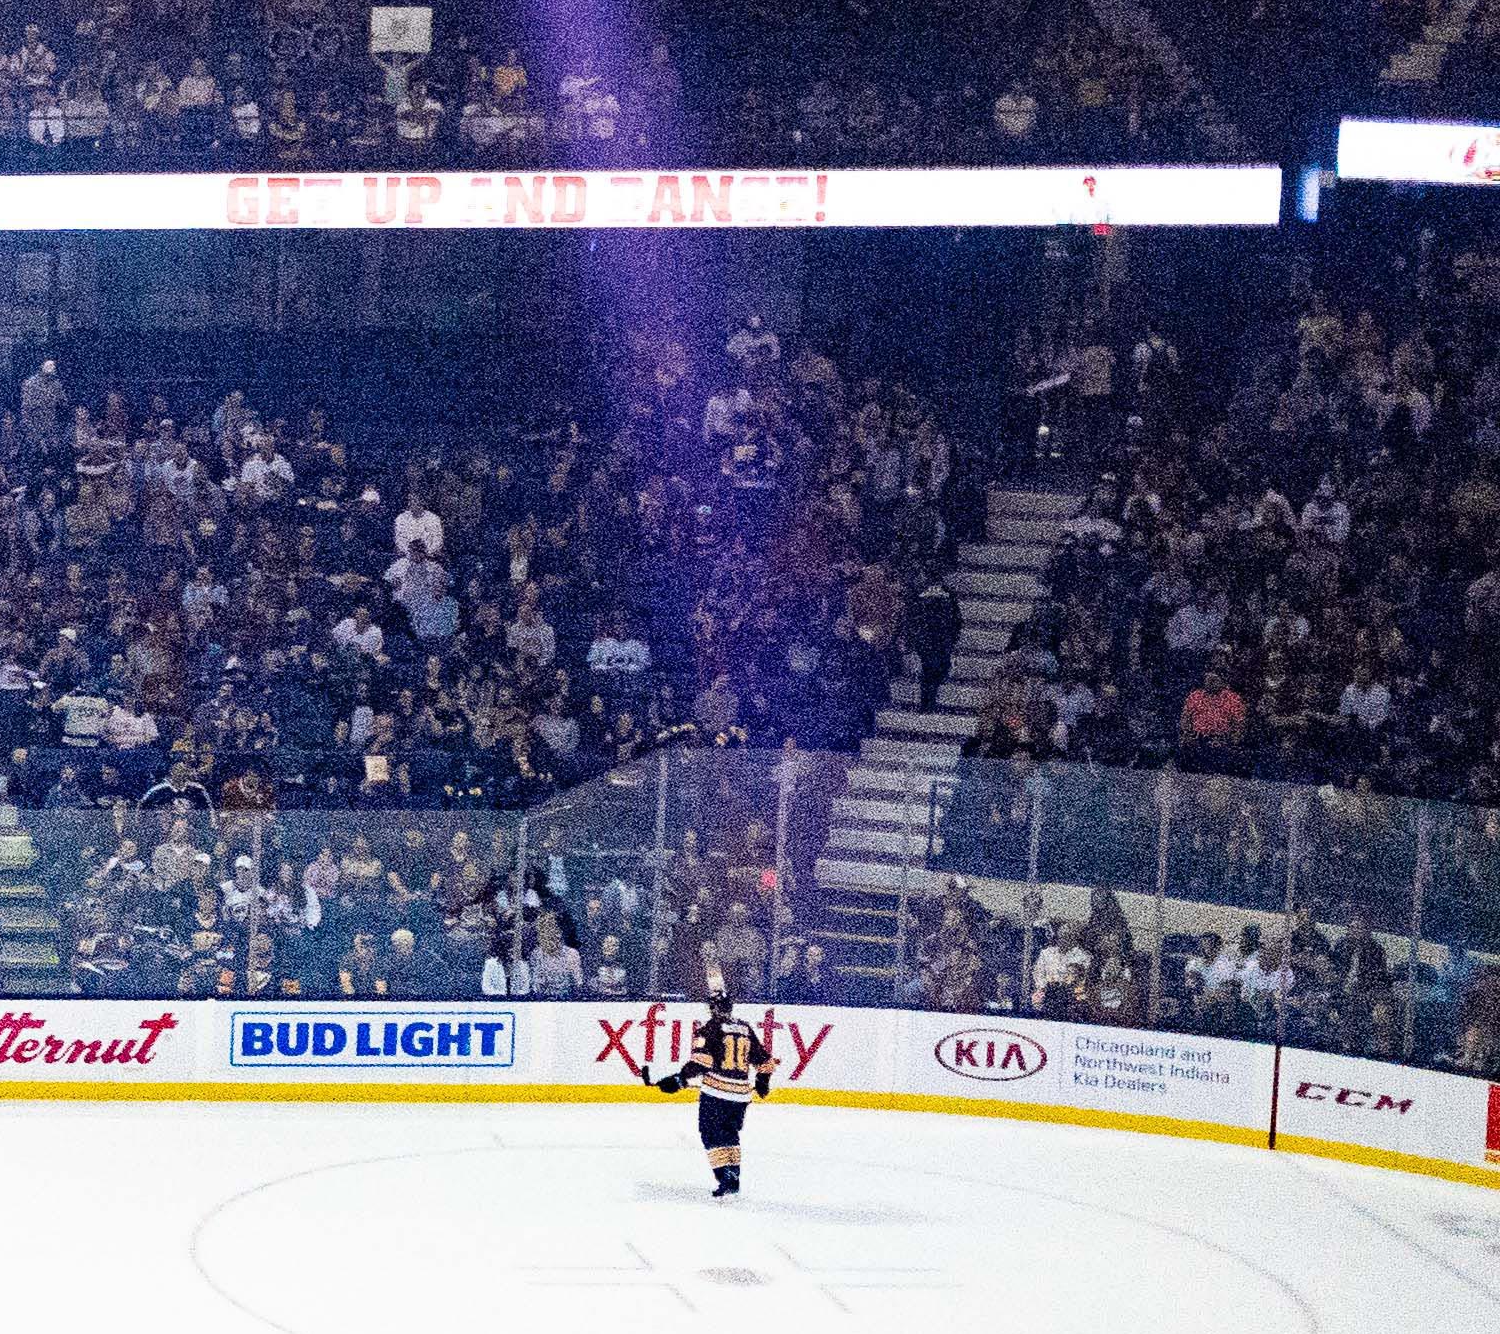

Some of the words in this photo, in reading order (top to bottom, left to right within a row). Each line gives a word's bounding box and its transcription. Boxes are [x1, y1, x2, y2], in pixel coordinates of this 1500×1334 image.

[363, 175, 444, 227] UP
[241, 1021, 347, 1057] BUD
[363, 1021, 505, 1058] LIGHT
[595, 1003, 834, 1080] xfity
[954, 1039, 1027, 1069] KIA
[1074, 1035, 1177, 1061] Chicagoland
[1180, 1047, 1212, 1064] and
[1073, 1053, 1164, 1077] Northwest
[1169, 1065, 1231, 1085] Indiana
[1073, 1072, 1100, 1087] Kia
[1104, 1074, 1168, 1095] Dealers
[1295, 1080, 1414, 1114] CCM
